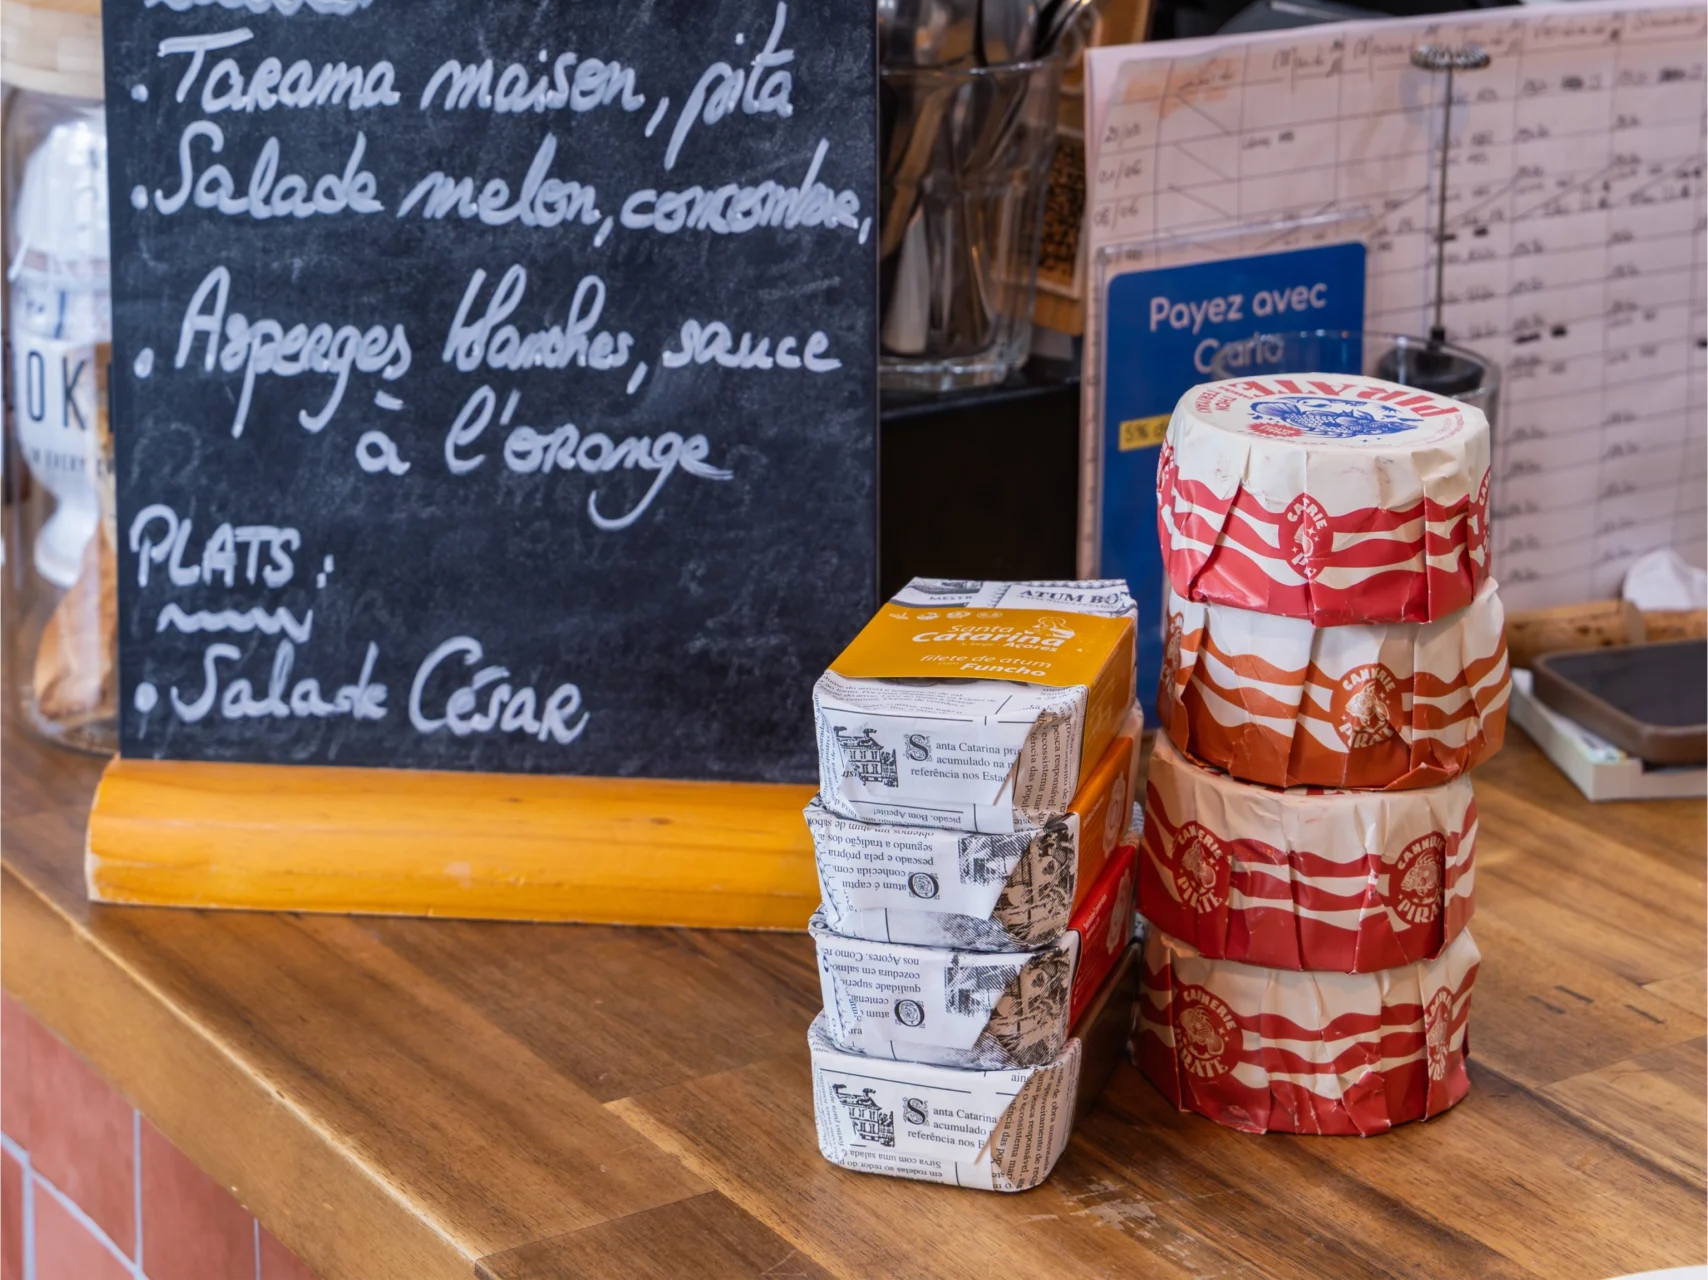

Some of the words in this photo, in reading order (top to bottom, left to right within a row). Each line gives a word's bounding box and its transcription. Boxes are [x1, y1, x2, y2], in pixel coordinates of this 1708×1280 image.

[664, 0, 794, 169] pita
[157, 121, 384, 219] Salade
[1150, 292, 1243, 335] Payez
[1252, 282, 1327, 317] avec
[175, 265, 411, 437] Asperges
[662, 318, 842, 374] sauce
[1242, 379, 1460, 417] PIRATE
[355, 392, 411, 475] à
[445, 384, 733, 530] l'orange
[1019, 589, 1078, 602] ATUM
[947, 624, 1015, 633] Santa
[912, 631, 1066, 648] Catarina
[972, 655, 996, 663] de
[999, 658, 1052, 668] atum
[960, 663, 1046, 677] Funcho
[171, 641, 387, 722] Salade
[1052, 724, 1060, 752] pesca
[959, 742, 1000, 754] Catarina
[936, 757, 990, 767] acumulado
[1039, 732, 1050, 792] ecossistema
[911, 767, 959, 779] referência
[963, 771, 979, 780] nos
[1028, 766, 1038, 783] das
[873, 808, 906, 819] Apetite!
[908, 812, 928, 822] Bom
[835, 819, 846, 828] de
[828, 834, 843, 843] dos
[845, 837, 883, 847] tradição
[893, 841, 932, 851] segundo
[828, 849, 861, 859] própria
[864, 852, 884, 862] pela
[895, 855, 934, 866] pescado
[857, 868, 906, 877] conhecida
[883, 882, 907, 891] atum
[835, 949, 863, 962] Como
[866, 953, 900, 966] Açores.
[878, 969, 920, 980] cozedura
[876, 983, 921, 993] qualidade
[866, 1010, 889, 1018] atum
[1053, 1089, 1061, 1100] de
[1029, 1094, 1039, 1119] pesca
[1050, 1101, 1058, 1122] obra
[956, 1109, 997, 1123] Catarina
[933, 1121, 986, 1136] acumulado
[1011, 1103, 1025, 1158] ecossistema
[908, 1130, 955, 1145] referência
[958, 1139, 975, 1148] nos
[1000, 1131, 1011, 1146] das
[850, 1150, 876, 1159] salada
[1035, 1153, 1042, 1165] de
[860, 1162, 882, 1170] redor
[897, 1167, 927, 1175] rodelas
[919, 1161, 942, 1169] Sirva
